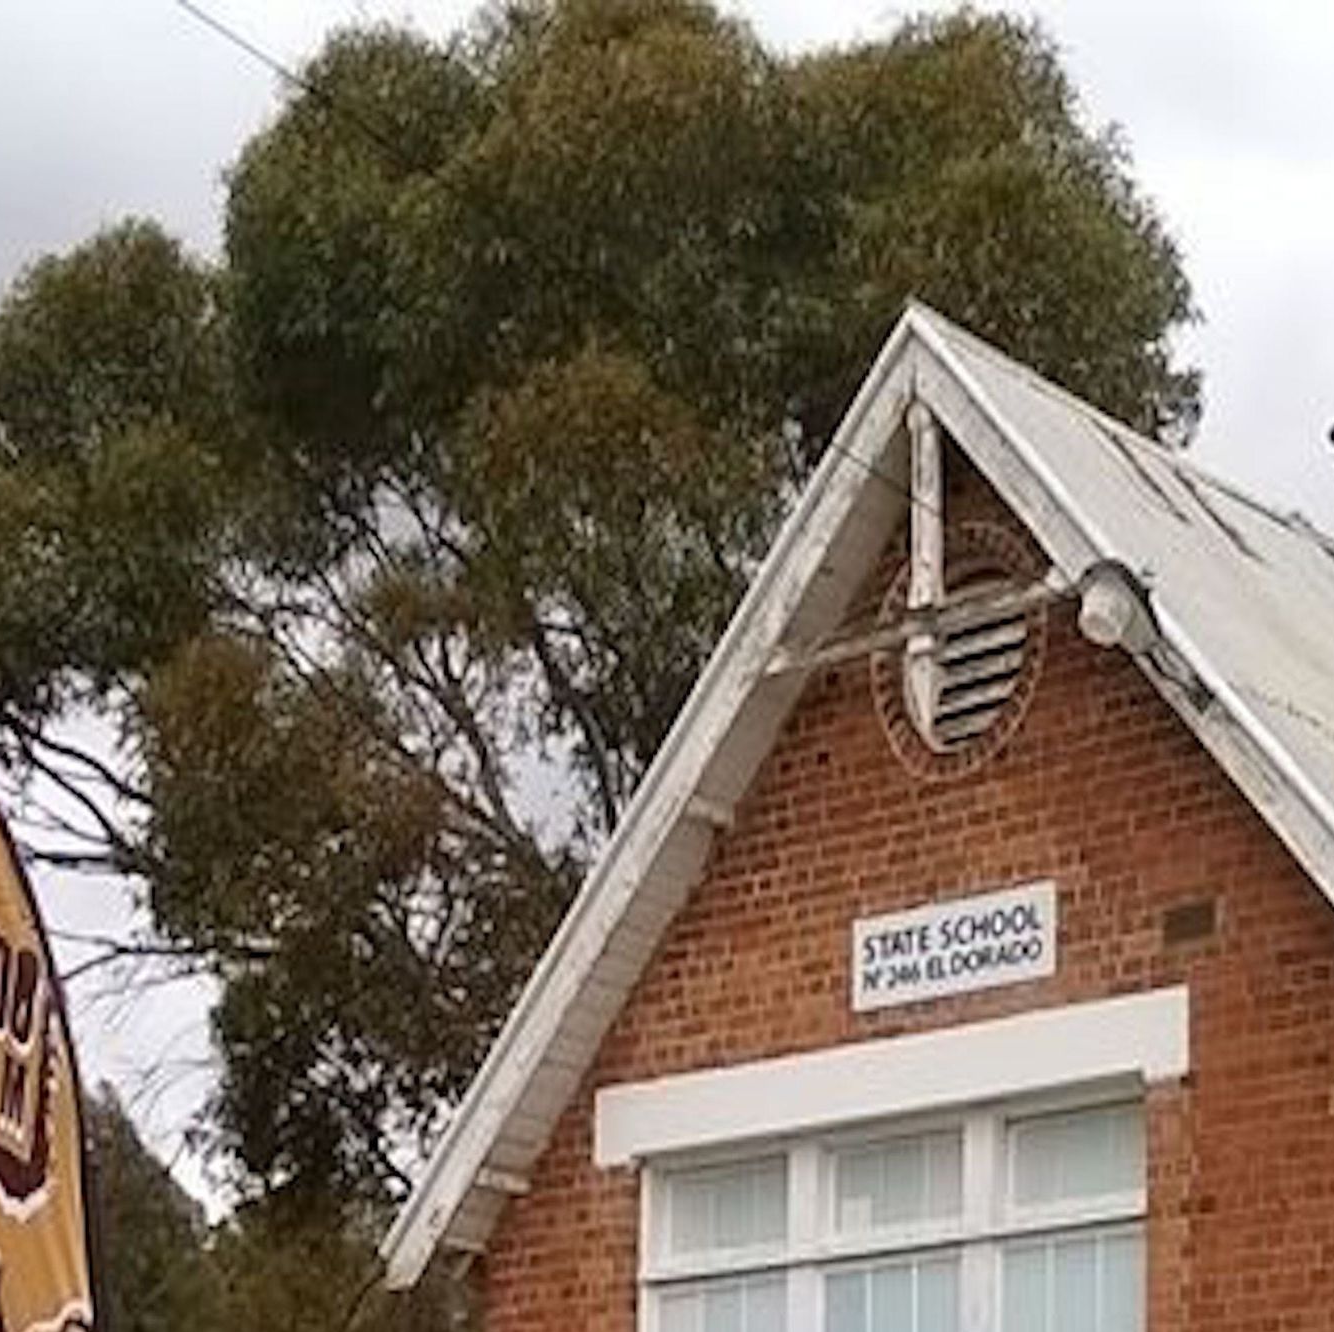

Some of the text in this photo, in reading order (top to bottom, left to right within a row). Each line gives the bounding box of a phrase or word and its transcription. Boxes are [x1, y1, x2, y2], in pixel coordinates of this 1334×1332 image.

[863, 903, 1043, 963] STATE SCHOOL
[926, 956, 947, 980] EL
[950, 937, 1043, 976] DORADO
